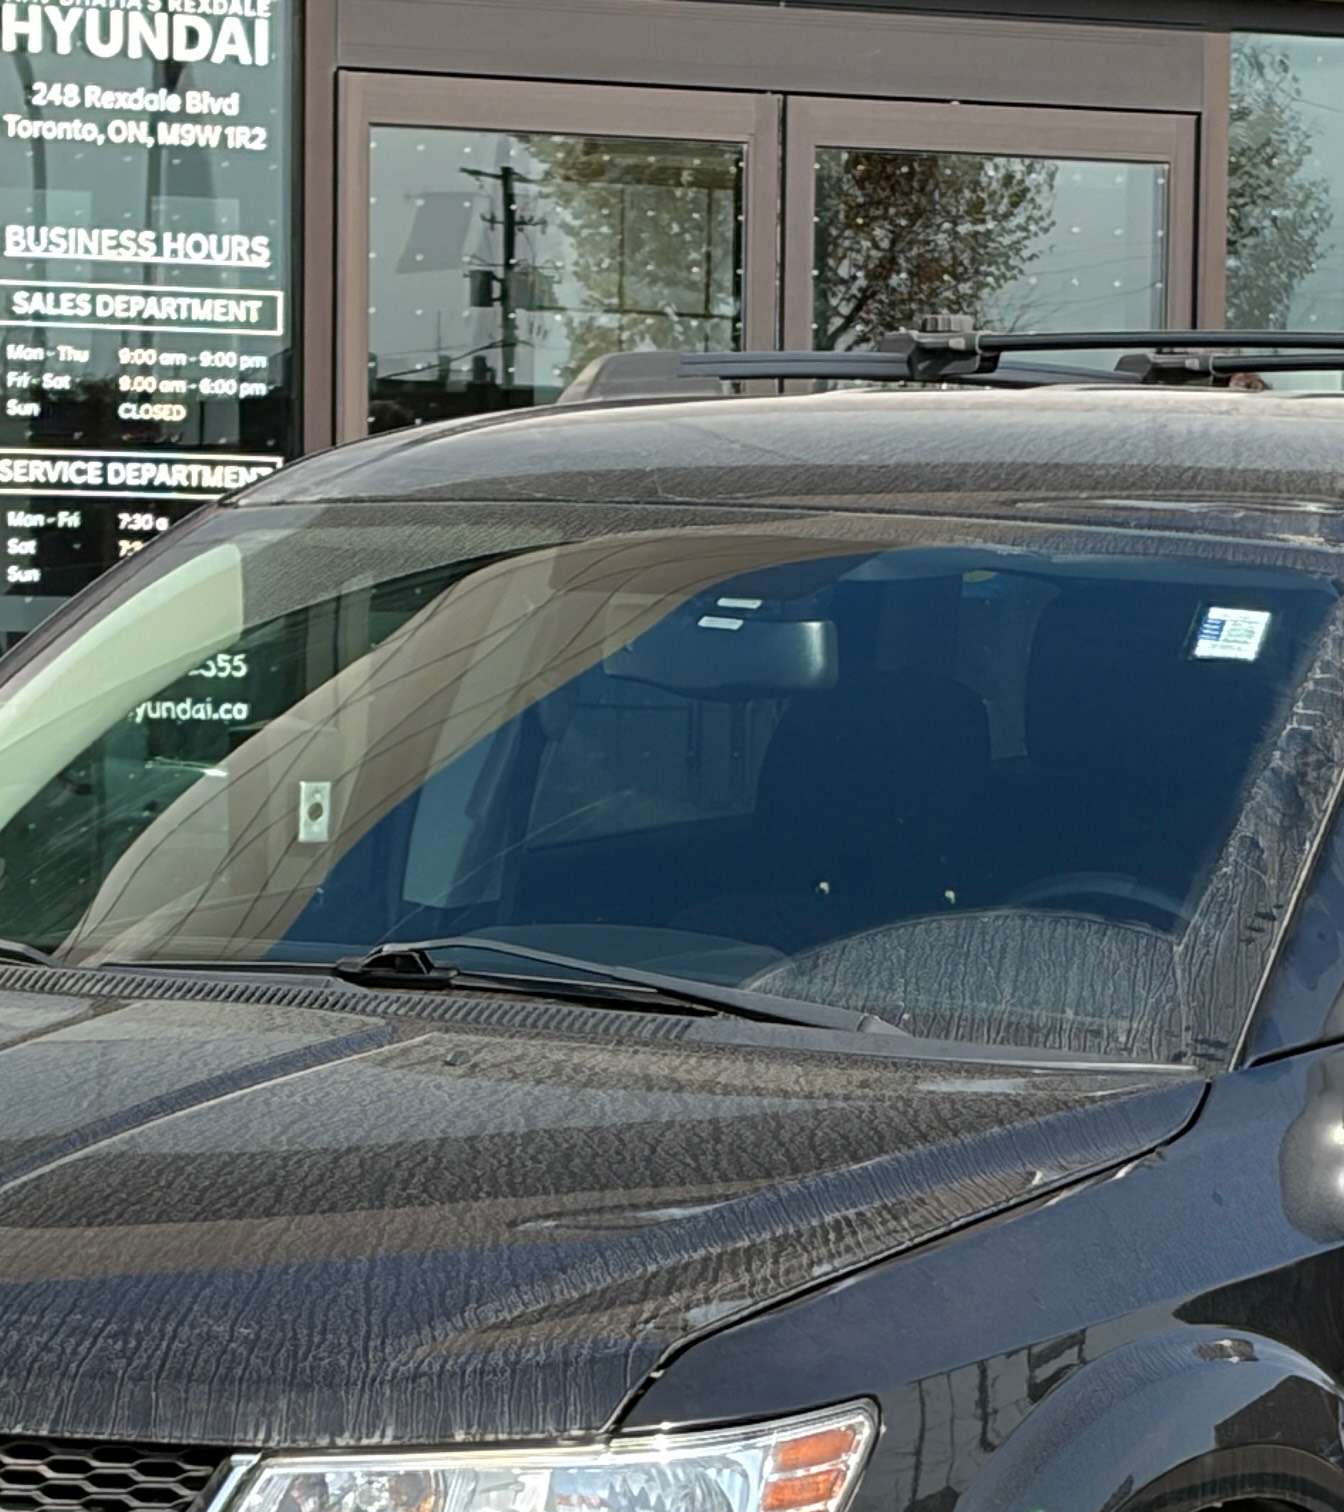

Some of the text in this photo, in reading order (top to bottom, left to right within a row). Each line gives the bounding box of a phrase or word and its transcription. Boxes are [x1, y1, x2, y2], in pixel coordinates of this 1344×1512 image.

[1, 4, 269, 66] HYUNDAI
[32, 82, 240, 116] 248 Rexdale Blvd
[3, 114, 267, 150] Toronto, ON, M9W 1R2
[5, 225, 271, 262] BUSINESS HOURS
[12, 291, 262, 322] SALES DEPARTMENT
[6, 344, 44, 361] Mon
[57, 345, 89, 362] Thu
[240, 355, 267, 371] pm
[42, 373, 71, 389] Sat
[6, 399, 40, 416] Sun
[118, 402, 187, 421] CLOSED
[7, 511, 45, 528] Mon
[57, 511, 81, 528] Fri
[156, 516, 169, 531] a
[7, 538, 36, 555] Sat
[7, 565, 41, 582] Sun
[128, 697, 250, 724] yundai.ca
